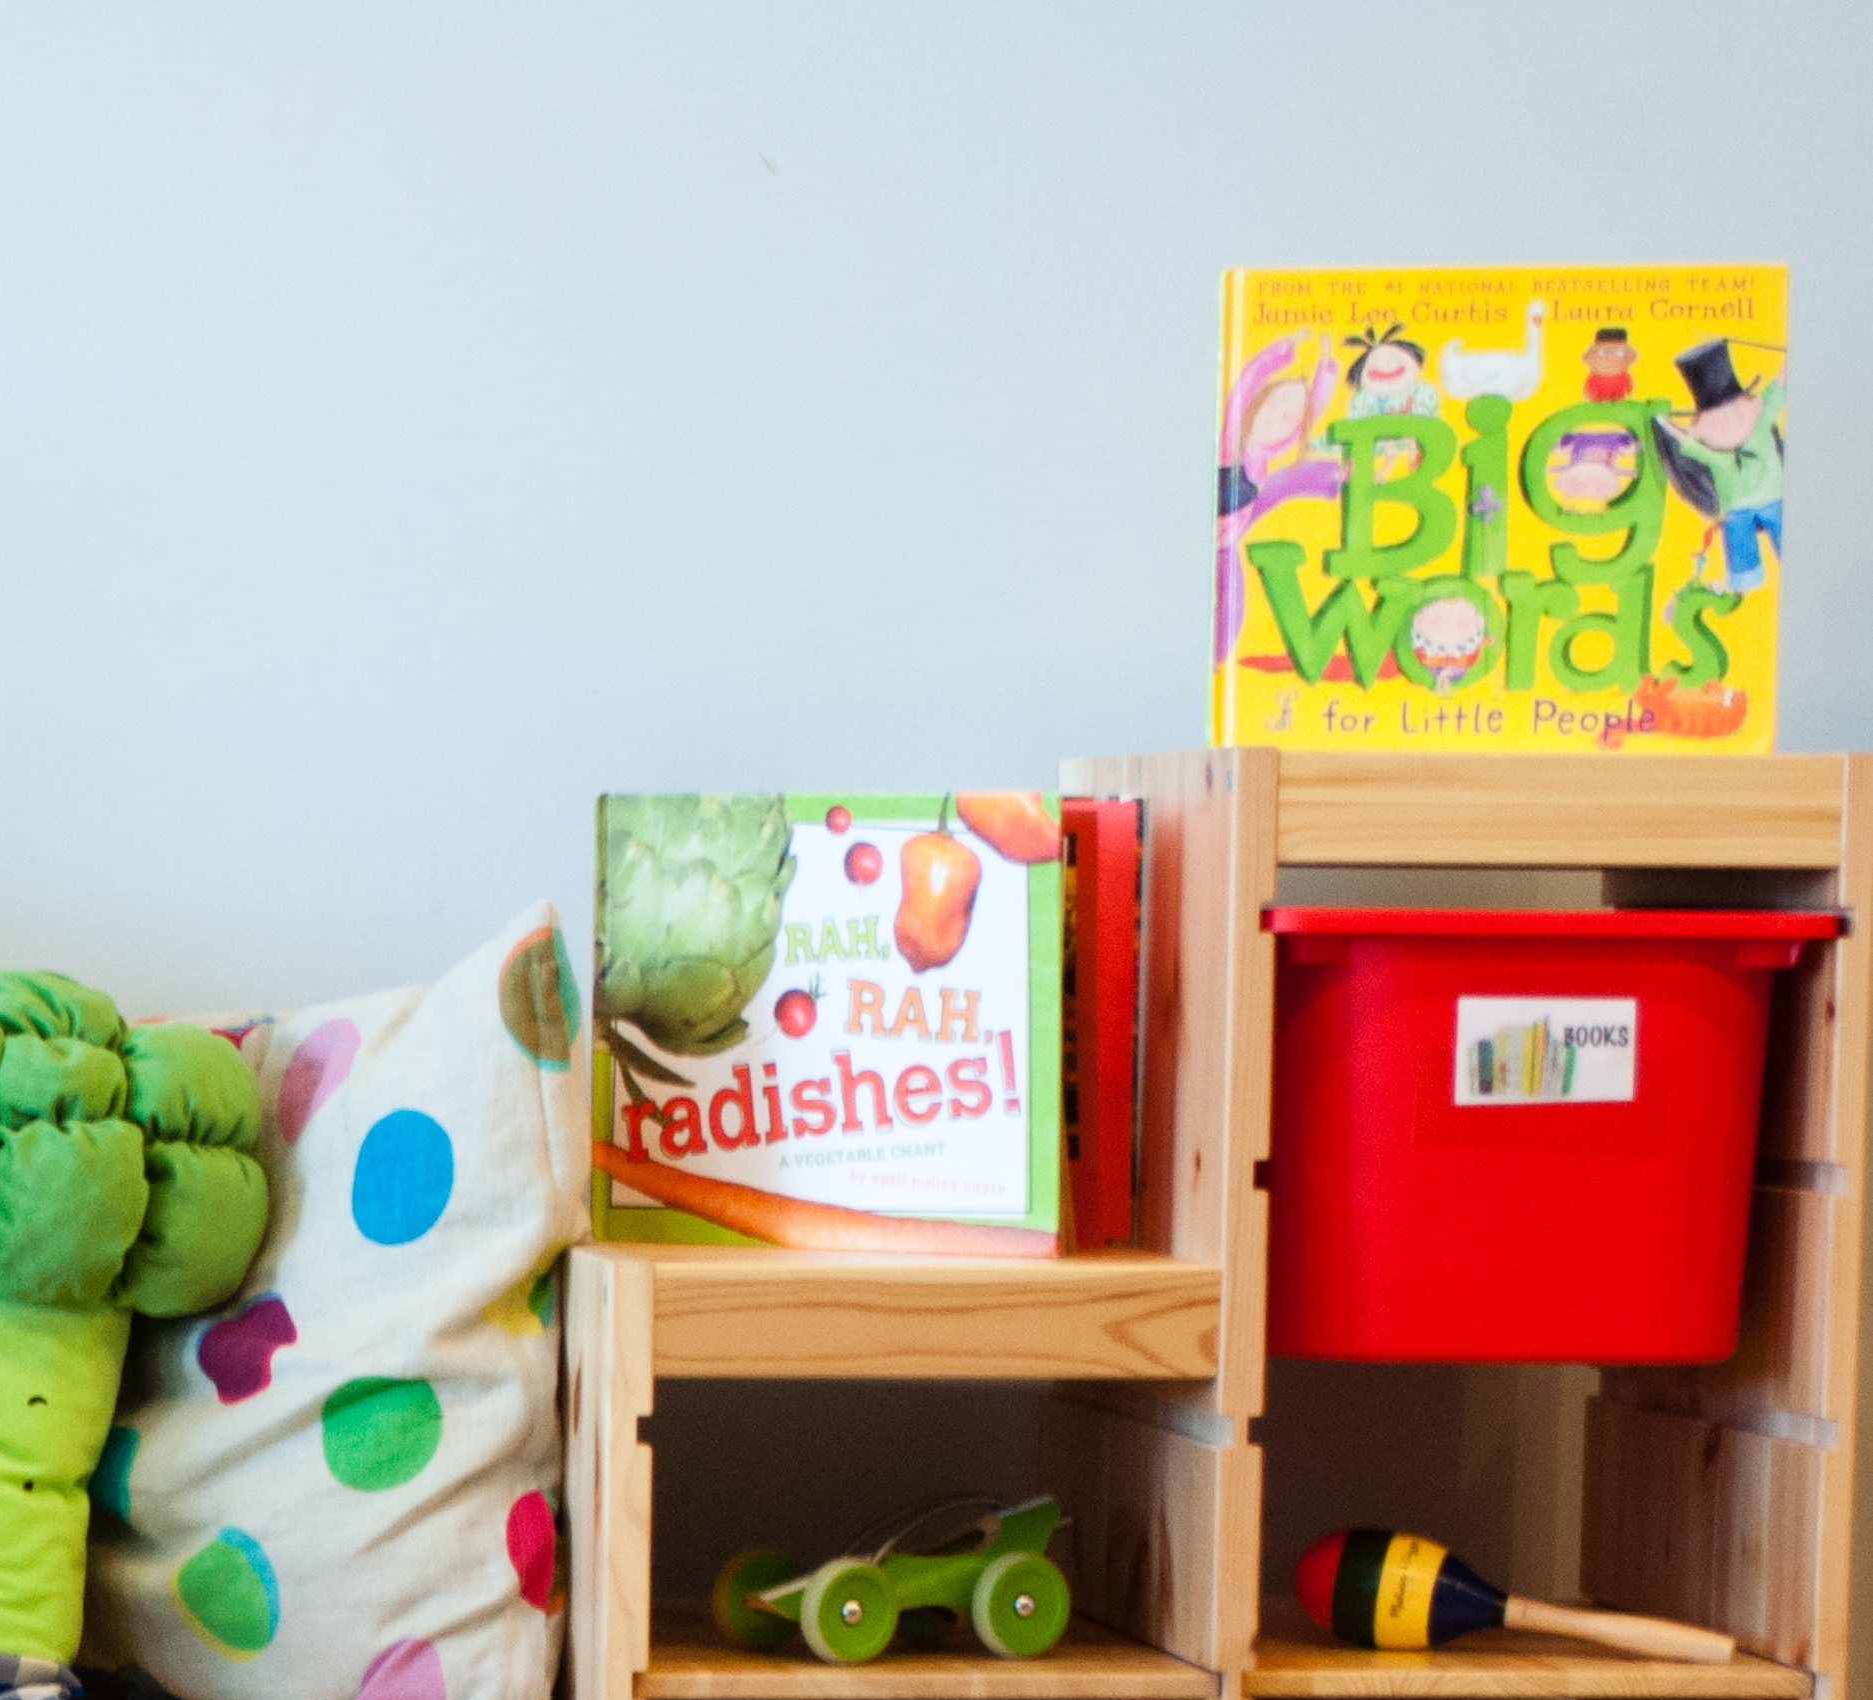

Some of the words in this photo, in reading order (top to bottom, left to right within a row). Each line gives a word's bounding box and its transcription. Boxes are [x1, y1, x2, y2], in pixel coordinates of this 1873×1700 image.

[1258, 281, 1311, 296] FROM
[1330, 280, 1365, 296] THE
[1419, 279, 1516, 294] NATIONAL
[1533, 277, 1671, 294] BESTSELLING
[1688, 276, 1755, 293] TEAM!
[1253, 301, 1333, 325] Jamie
[1350, 301, 1397, 323] Lee
[1411, 300, 1508, 324] Curtis
[1552, 297, 1634, 322] Laura
[1649, 296, 1755, 320] Cornell
[1322, 700, 1375, 735] for
[1402, 700, 1503, 733] Little
[1533, 699, 1657, 741] People
[785, 917, 890, 966] RAH,
[844, 979, 997, 1046] RAH,
[1563, 1026, 1629, 1047] BOOKS
[621, 1030, 1021, 1163] radishes!
[794, 1147, 886, 1169] VEGETABLE
[891, 1142, 946, 1159] CHANT
